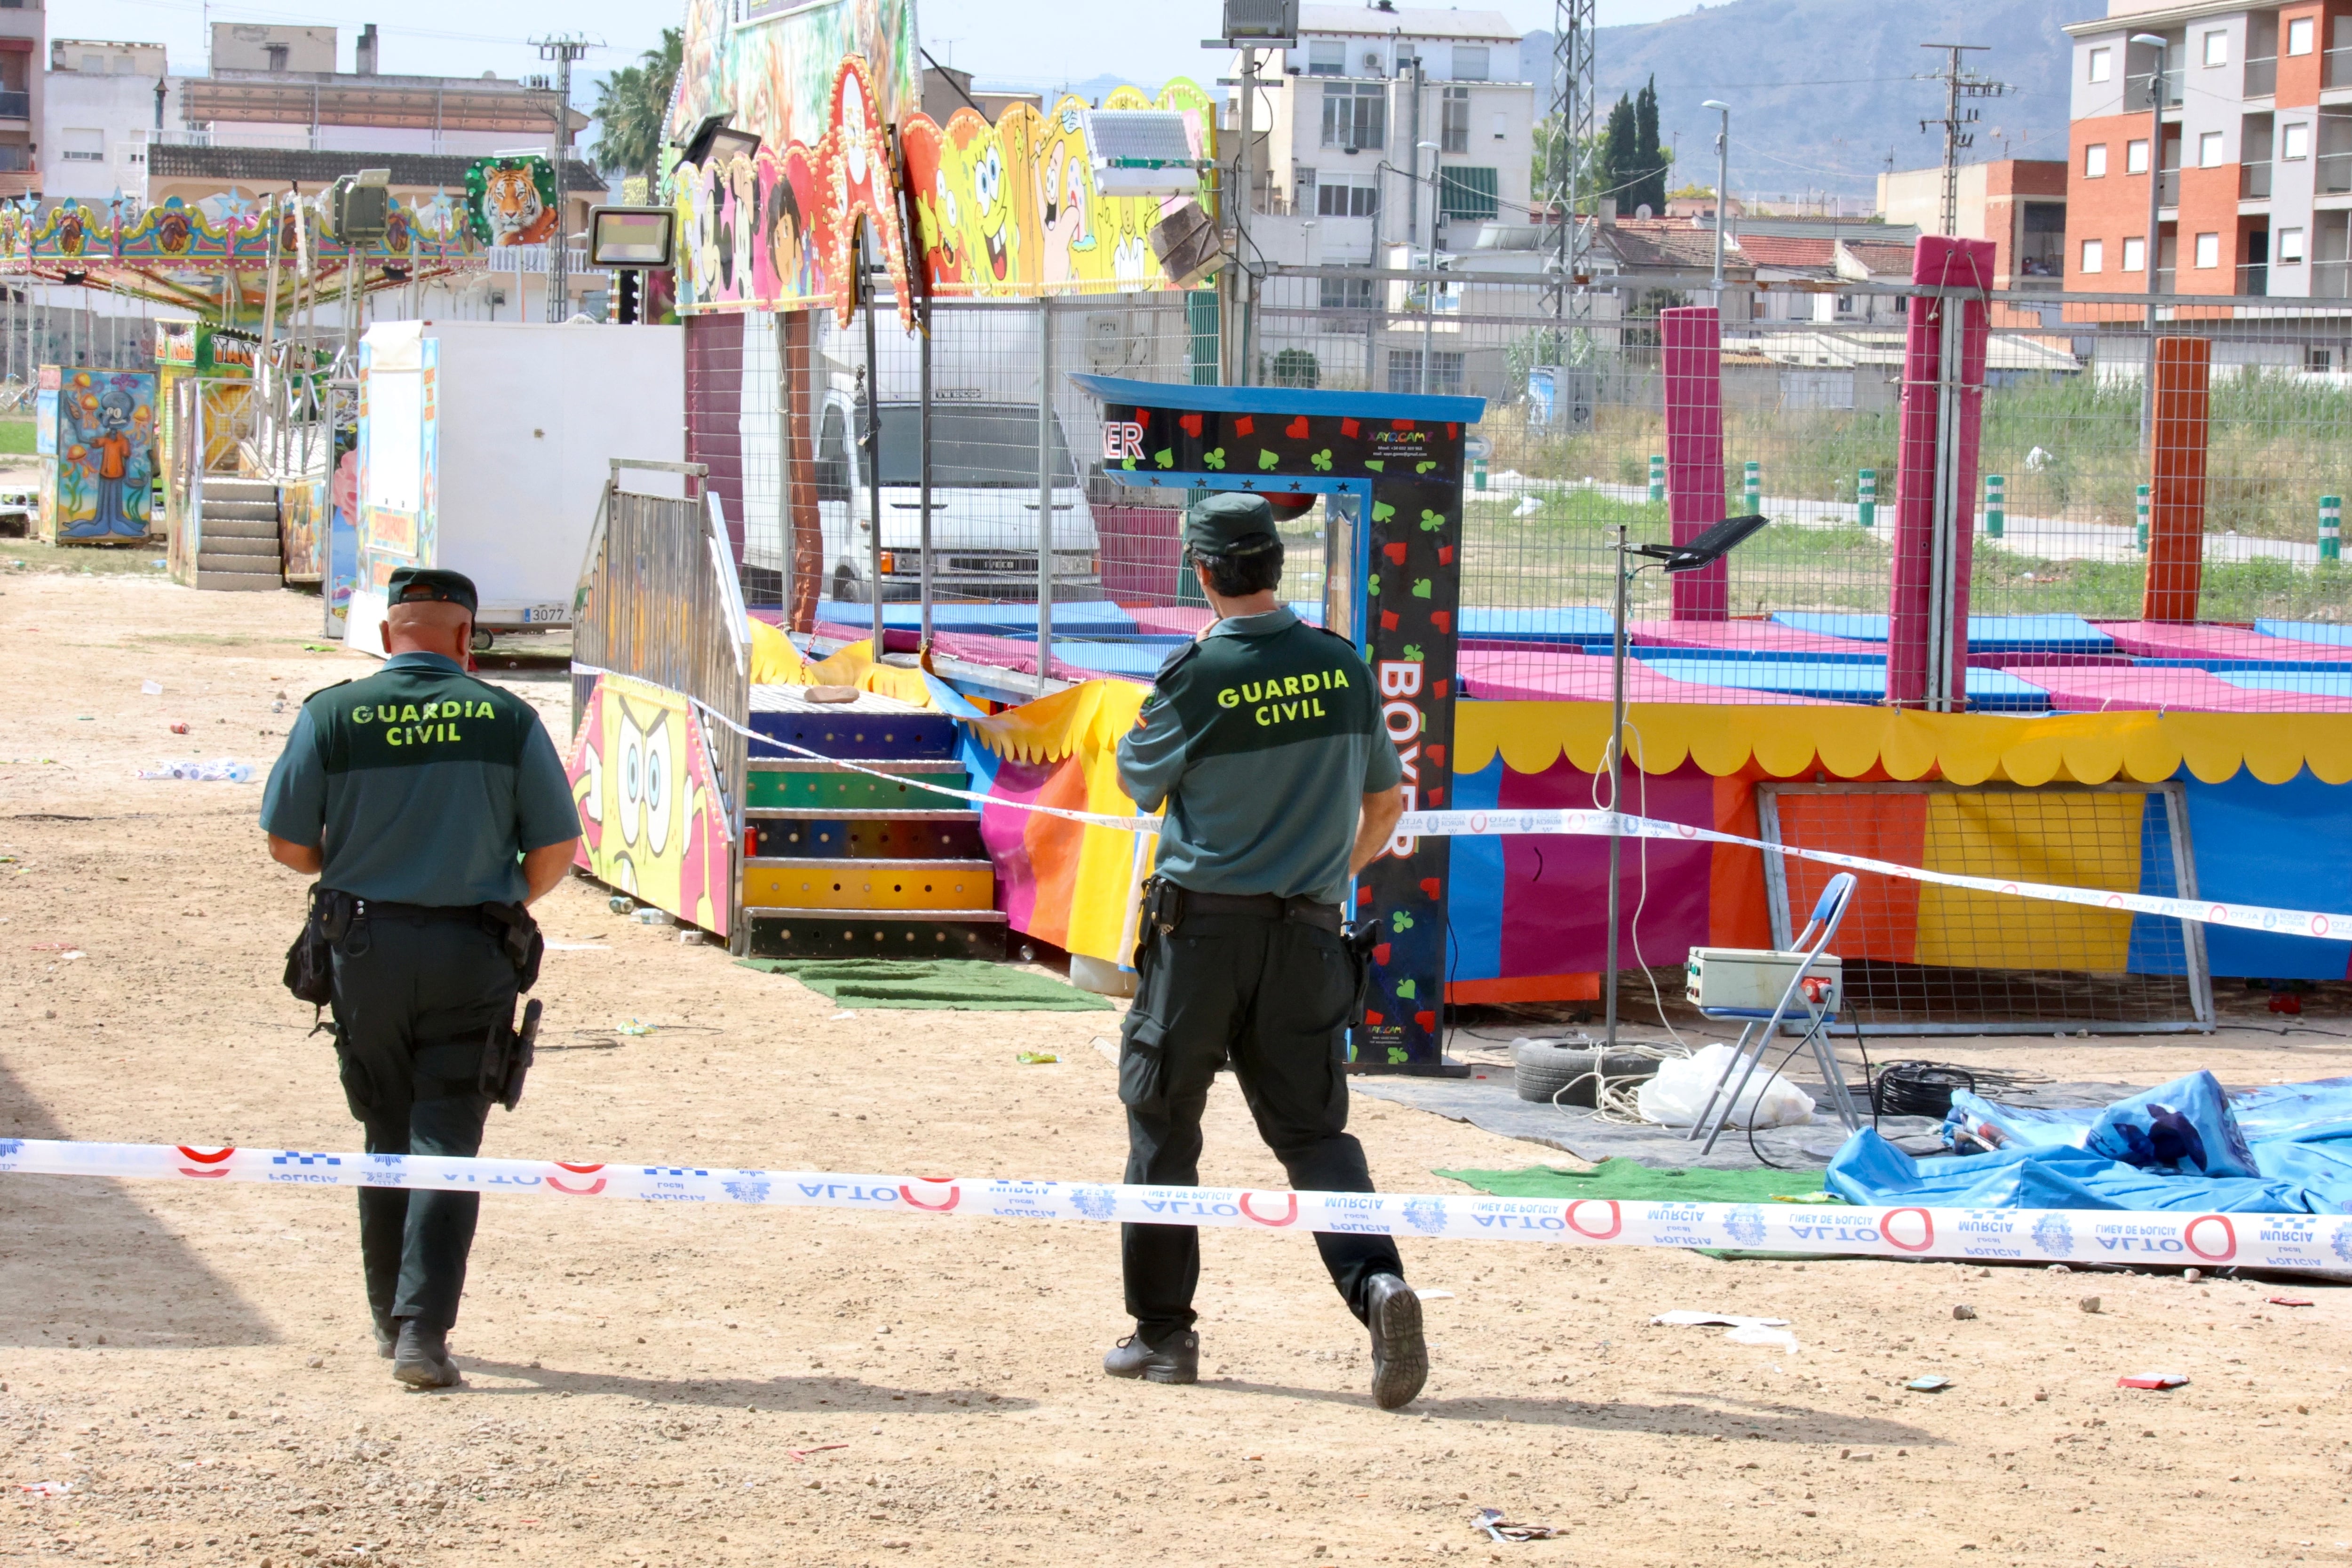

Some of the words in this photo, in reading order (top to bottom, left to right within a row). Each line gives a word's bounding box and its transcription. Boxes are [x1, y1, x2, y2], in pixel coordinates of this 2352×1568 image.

[533, 609, 564, 621] 3077
[1218, 669, 1349, 708] GUARDIA
[352, 700, 495, 724] GUARDIA
[1255, 698, 1326, 726] CIVIL
[386, 723, 461, 746] CIVIL
